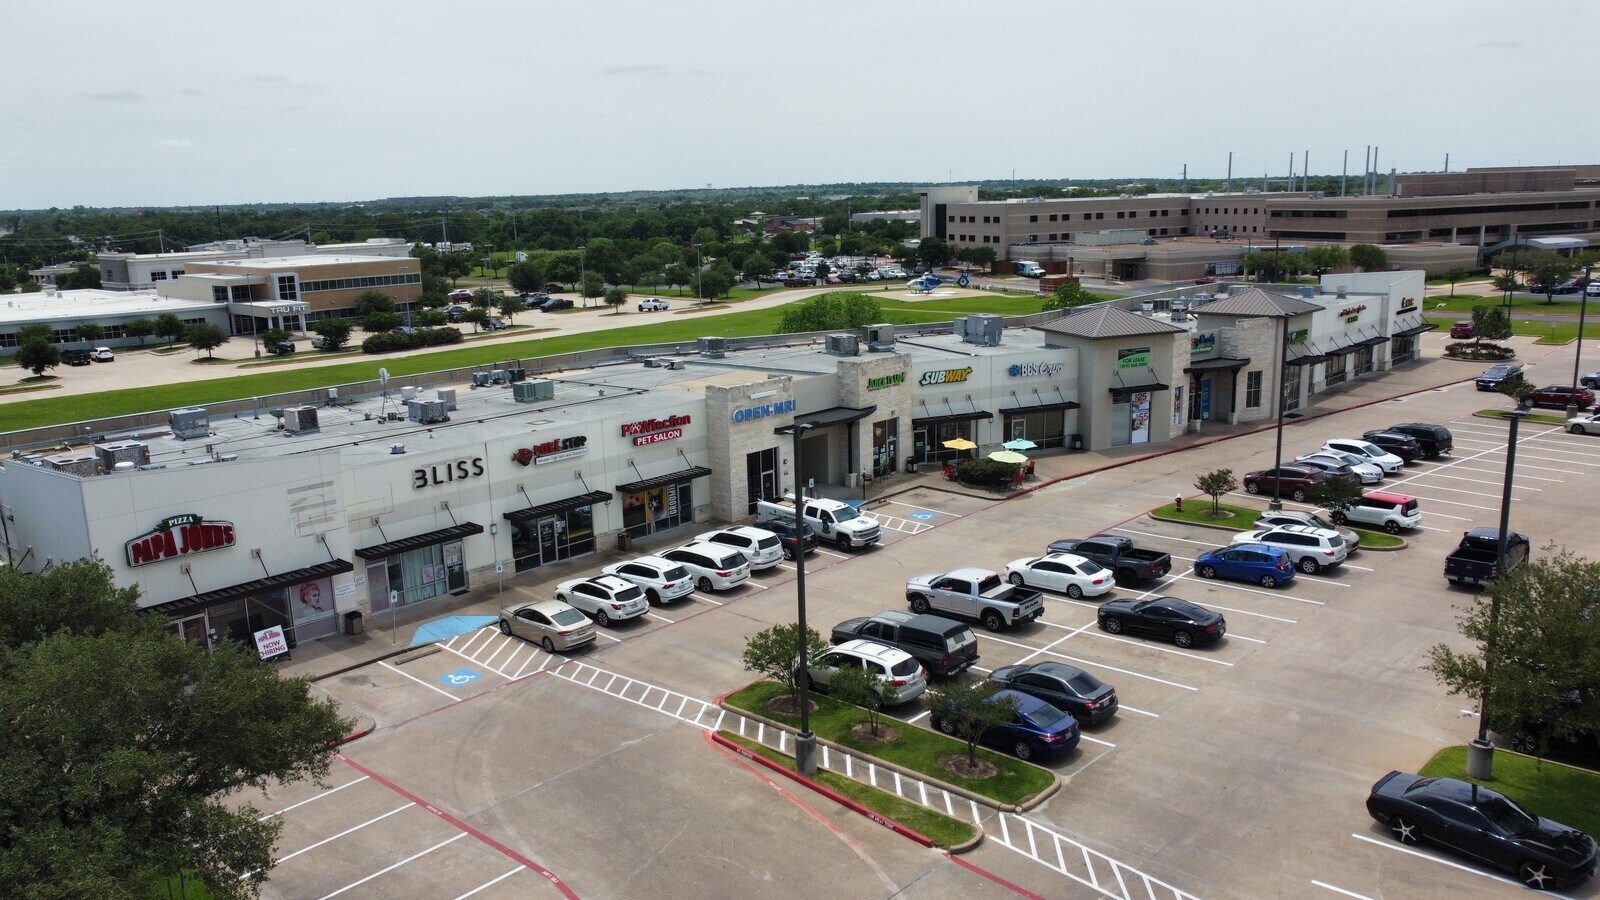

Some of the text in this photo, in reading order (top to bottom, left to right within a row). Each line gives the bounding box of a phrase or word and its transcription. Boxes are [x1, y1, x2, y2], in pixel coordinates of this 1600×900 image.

[270, 306, 290, 314] TRU
[919, 366, 974, 387] SUBWAY
[733, 399, 797, 424] OPEN MRI
[561, 435, 587, 450] STOP
[637, 429, 680, 446] PET SALON
[412, 457, 485, 490] BLISS
[168, 516, 193, 527] PIZZA
[131, 530, 178, 564] PAPA
[261, 645, 286, 657] HIRING
[262, 640, 280, 650] NOW
